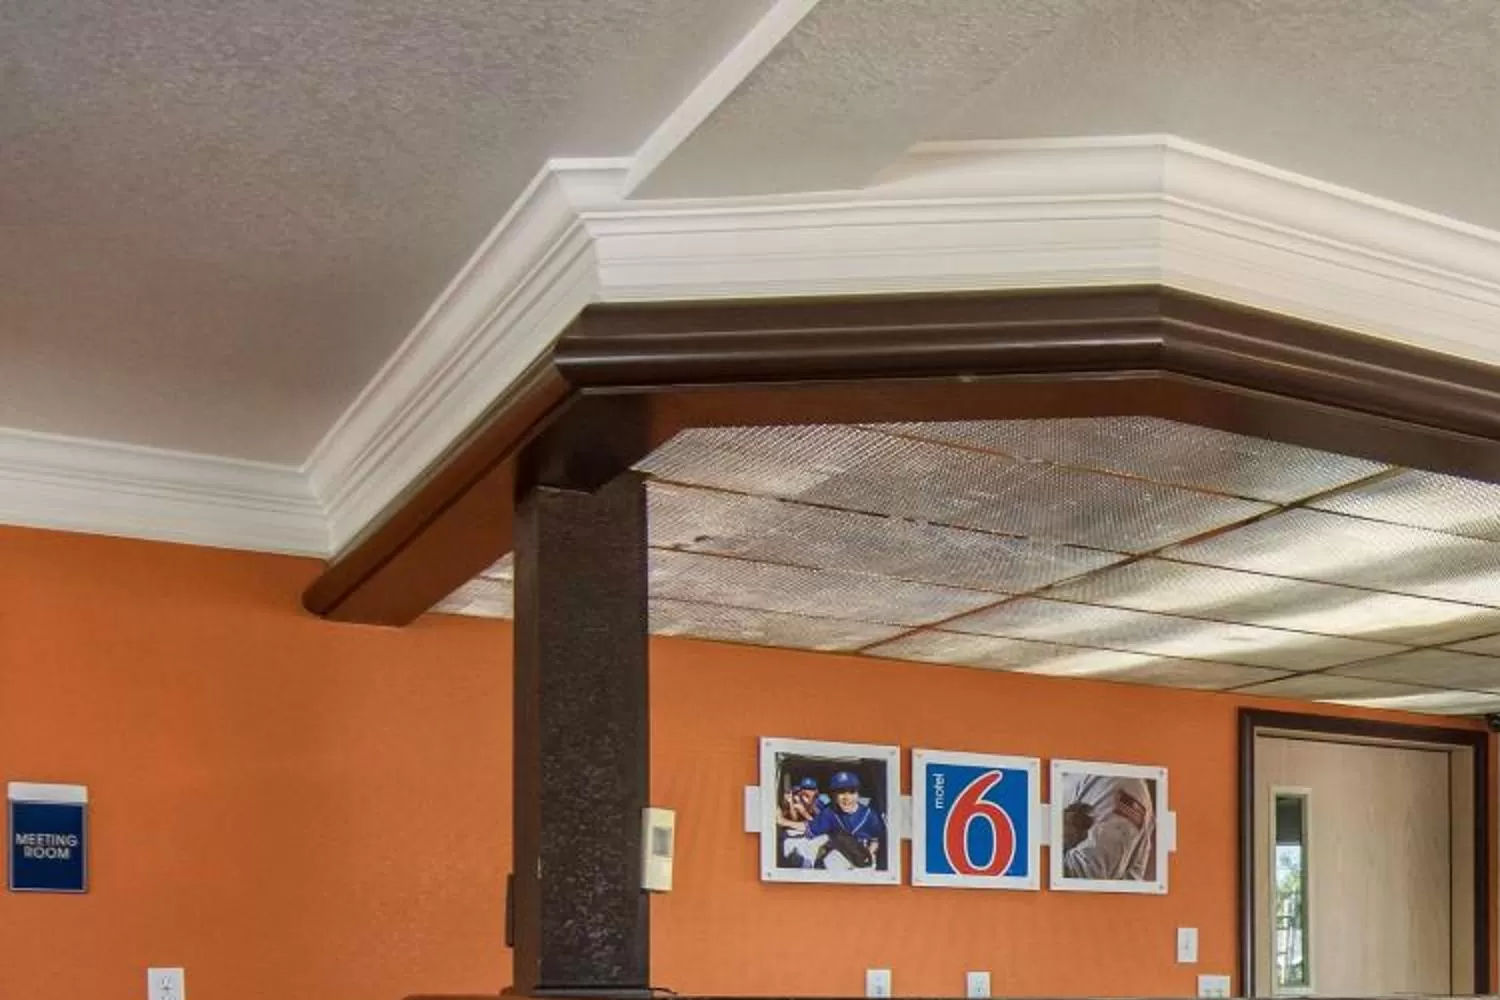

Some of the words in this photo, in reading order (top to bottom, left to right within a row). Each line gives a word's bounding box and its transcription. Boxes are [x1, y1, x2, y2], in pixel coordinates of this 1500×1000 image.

[932, 773, 945, 809] motel
[943, 769, 1017, 877] 6
[15, 833, 78, 847] MEETING
[23, 846, 70, 859] ROOM
